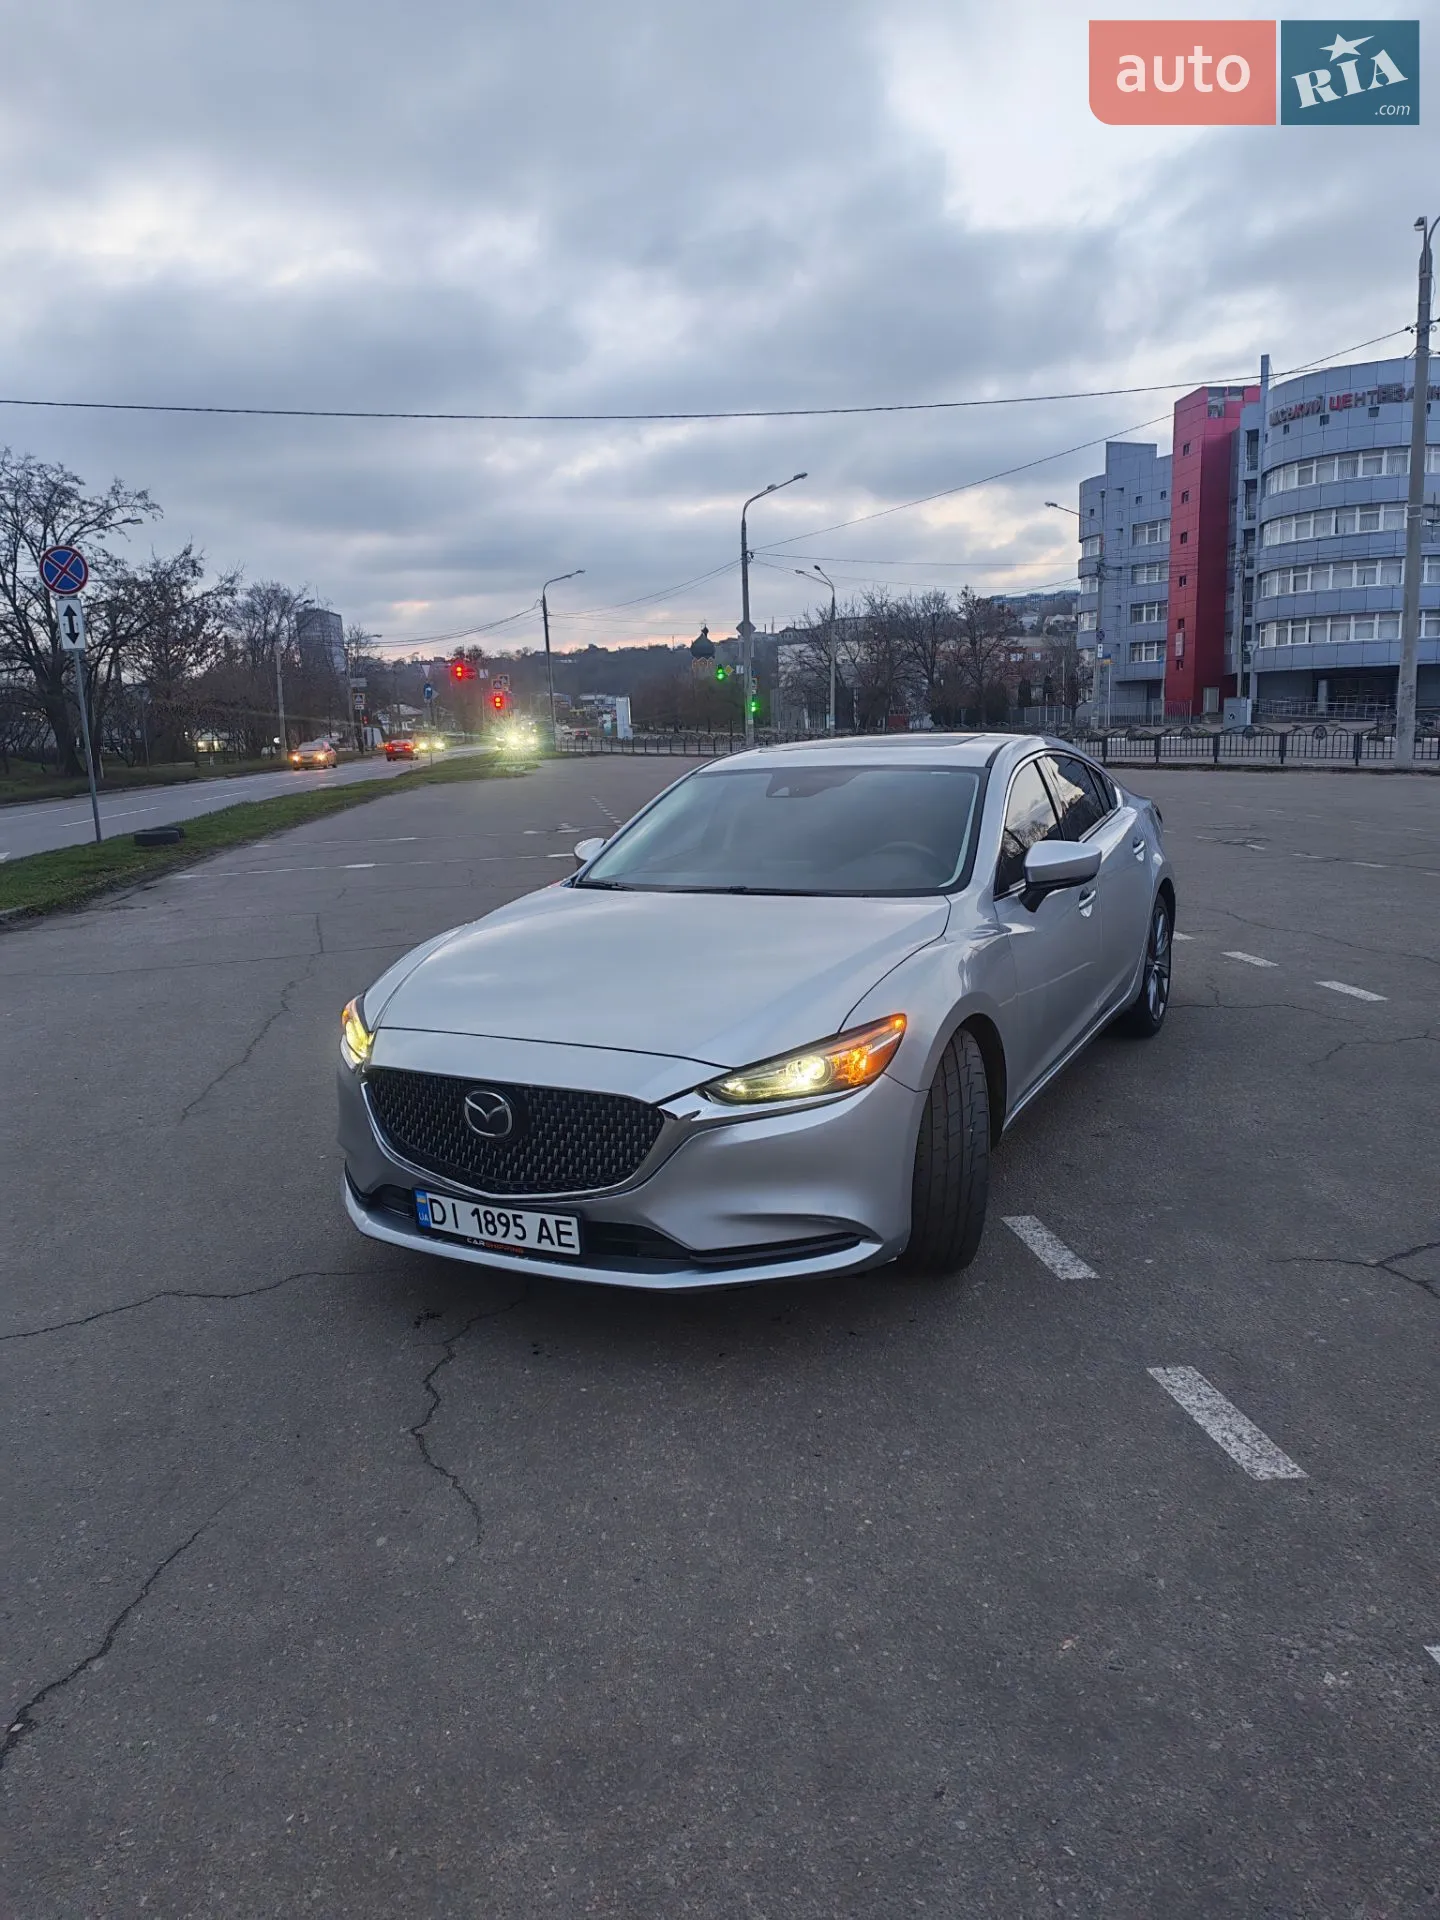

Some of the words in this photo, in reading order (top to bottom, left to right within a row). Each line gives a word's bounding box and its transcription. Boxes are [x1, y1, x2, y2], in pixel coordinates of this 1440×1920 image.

[418, 1212, 430, 1222] UA
[428, 1197, 459, 1229] DI
[471, 1207, 527, 1241] 1895
[537, 1217, 575, 1248] AE
